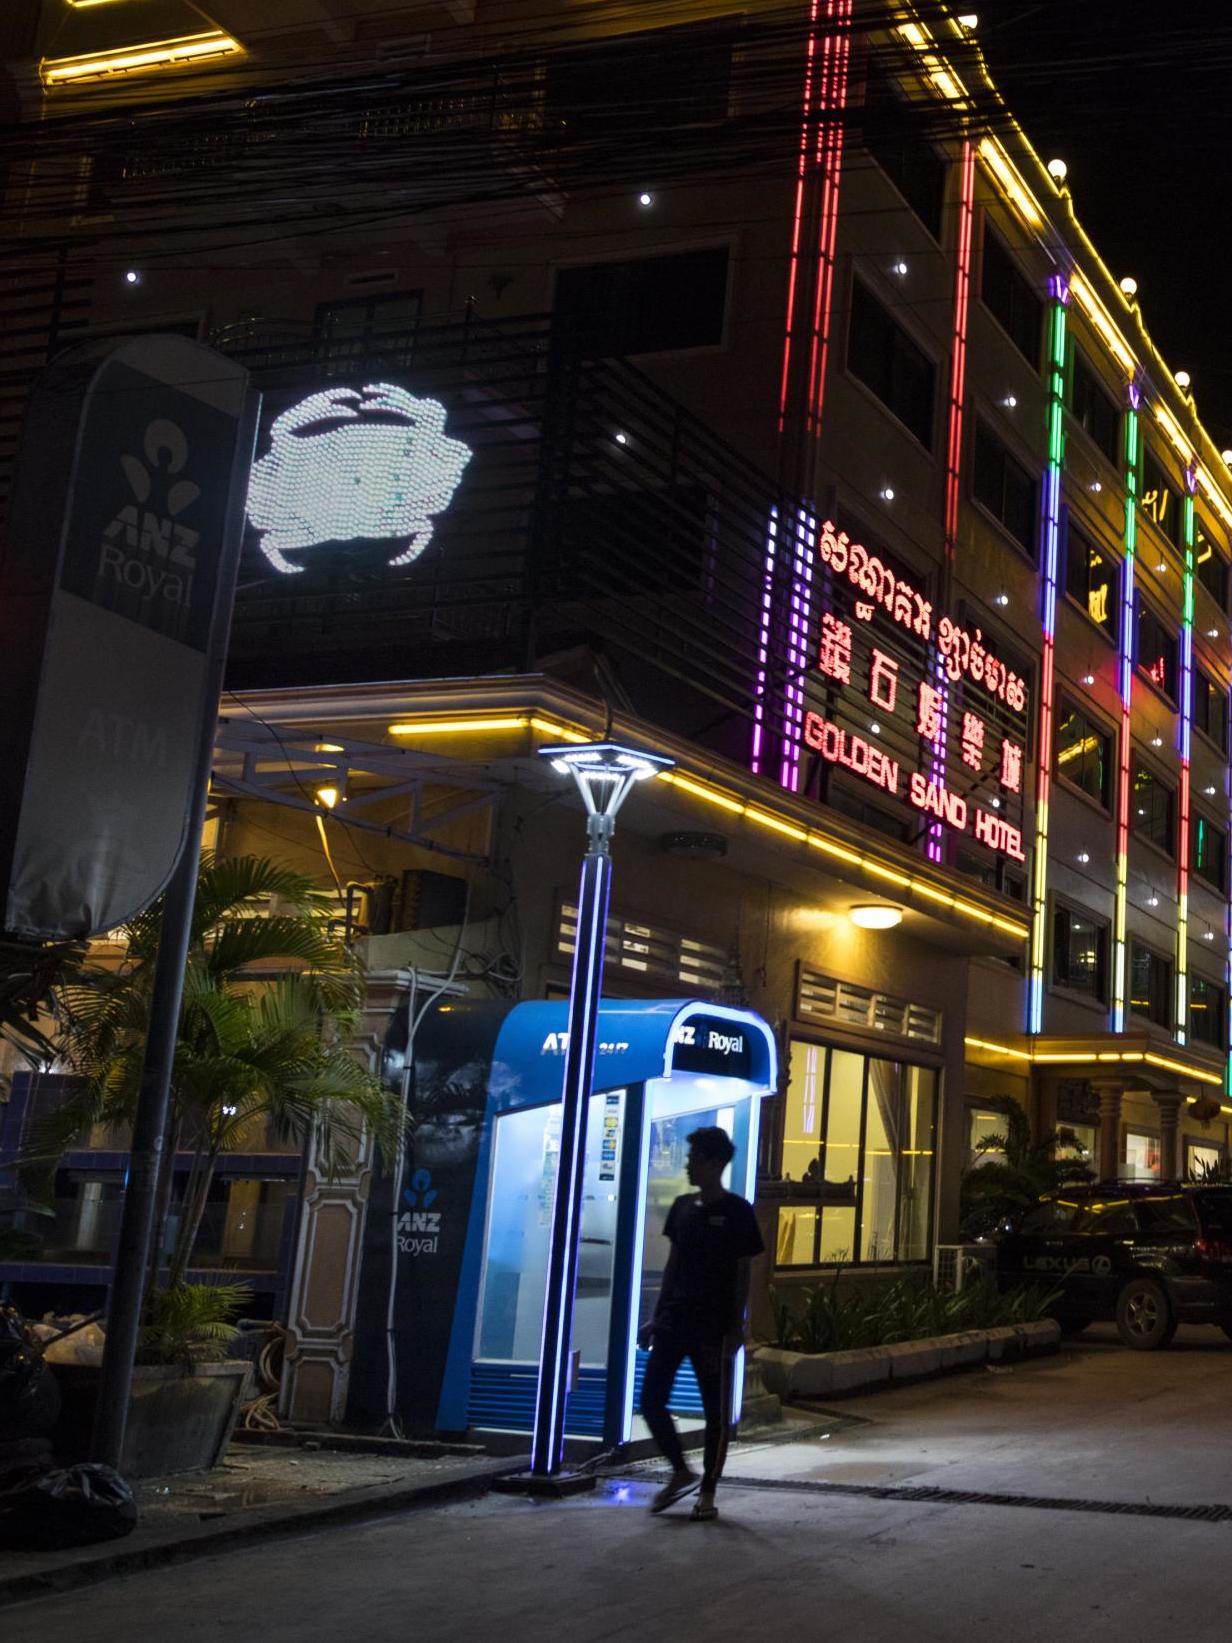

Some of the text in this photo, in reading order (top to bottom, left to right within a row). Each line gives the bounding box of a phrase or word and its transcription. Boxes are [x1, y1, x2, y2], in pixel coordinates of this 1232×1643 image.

[103, 504, 200, 570] ANZ
[99, 543, 193, 608] Royal
[77, 707, 168, 767] ATM
[803, 710, 1026, 863] GOLDEN SAND HOTEL
[541, 1032, 571, 1056] AT
[708, 1031, 743, 1056] Royal
[397, 1211, 442, 1233] ANZ
[397, 1235, 439, 1257] Royal
